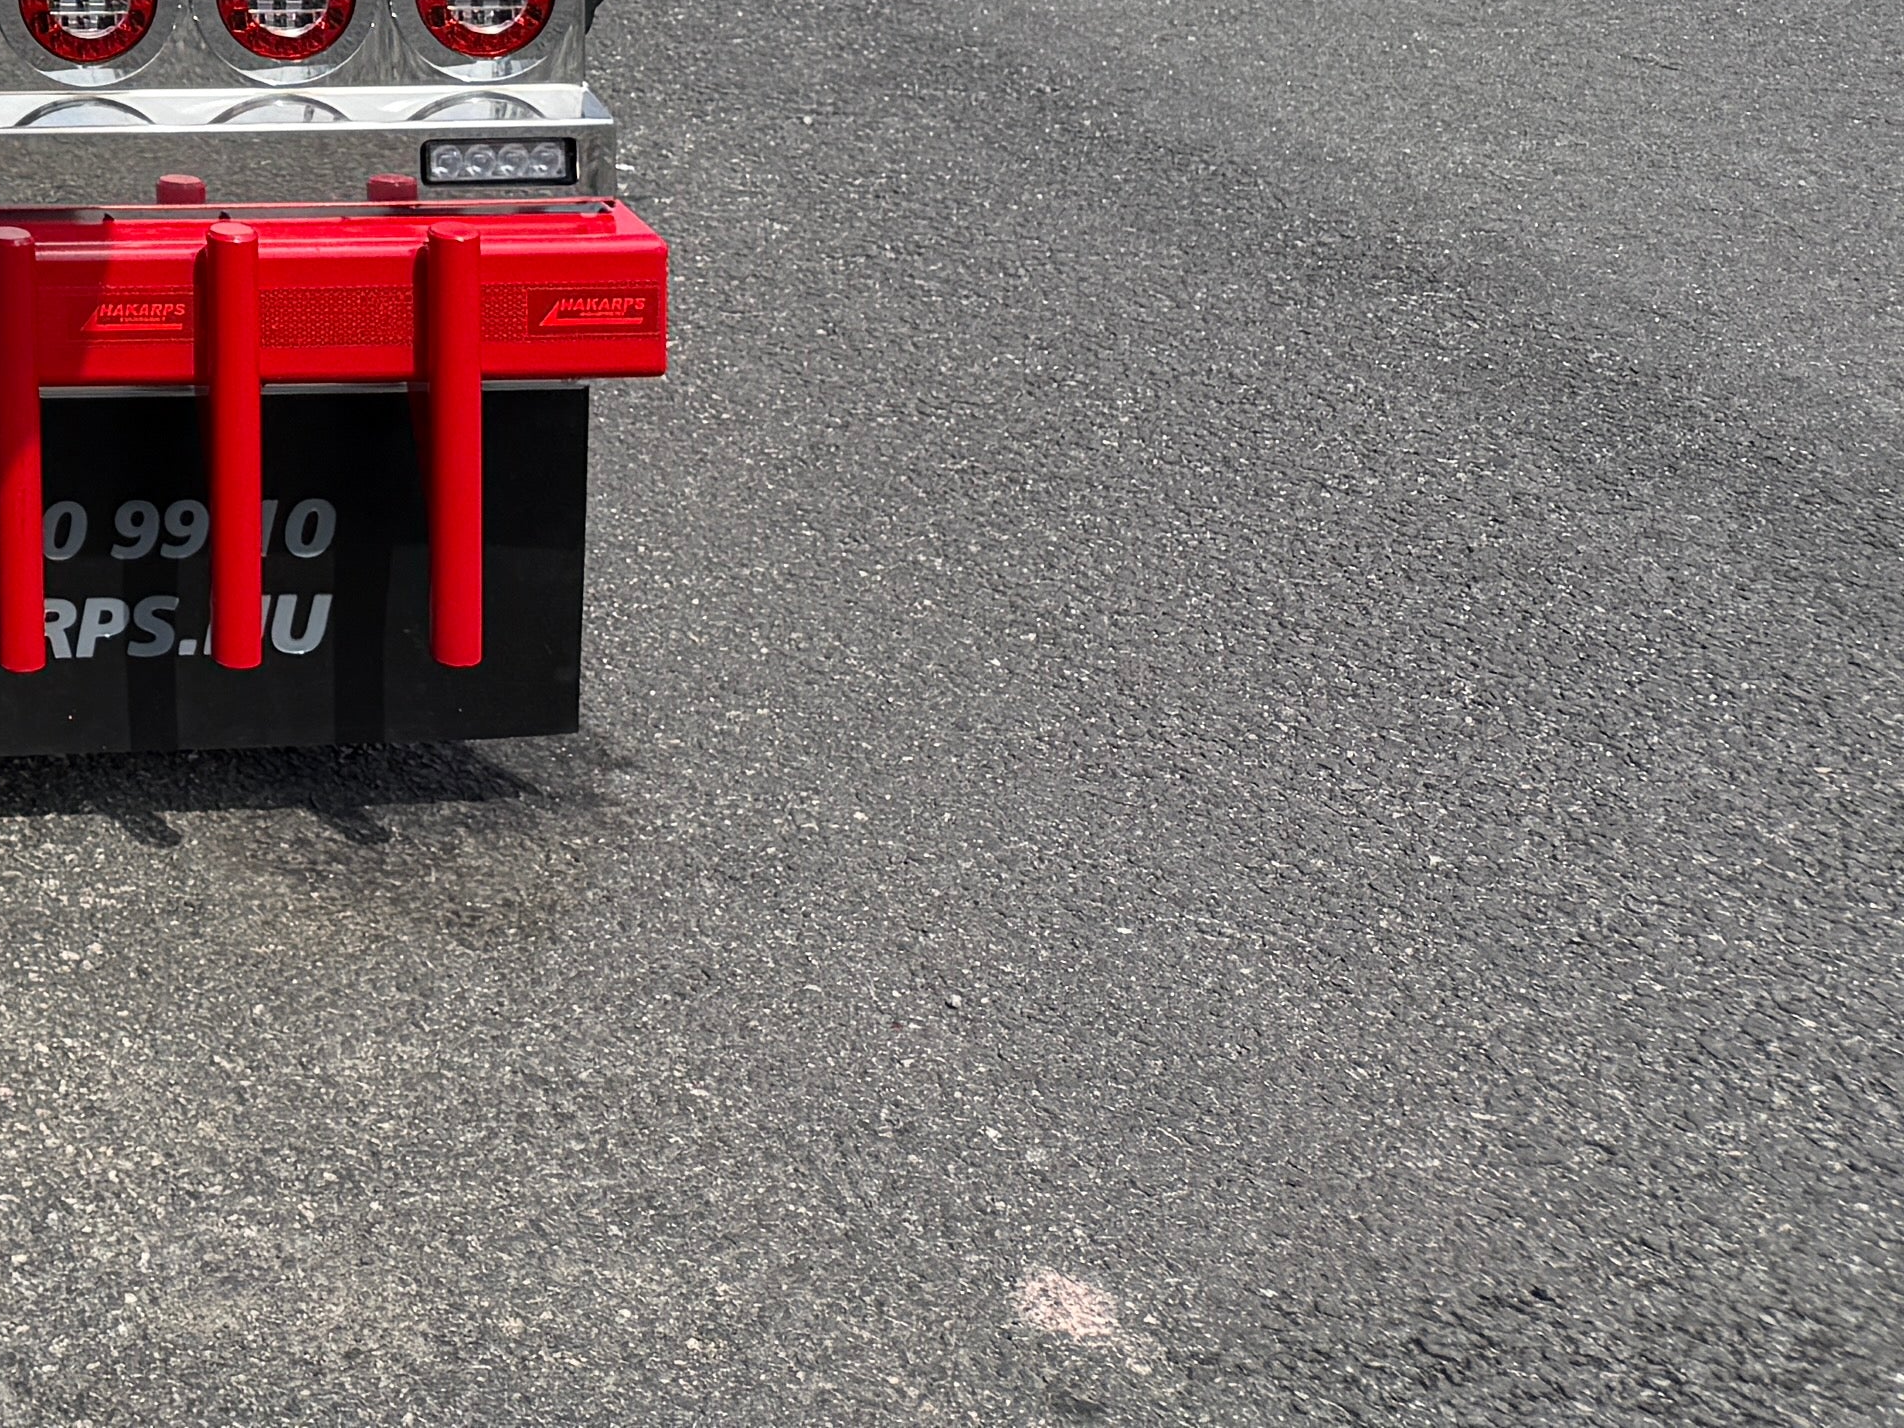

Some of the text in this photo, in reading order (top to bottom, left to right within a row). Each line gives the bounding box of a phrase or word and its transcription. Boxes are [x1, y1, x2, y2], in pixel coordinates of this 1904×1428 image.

[99, 303, 186, 317] HAKARPS
[560, 297, 646, 311] HAKARPS
[110, 499, 209, 562] 99
